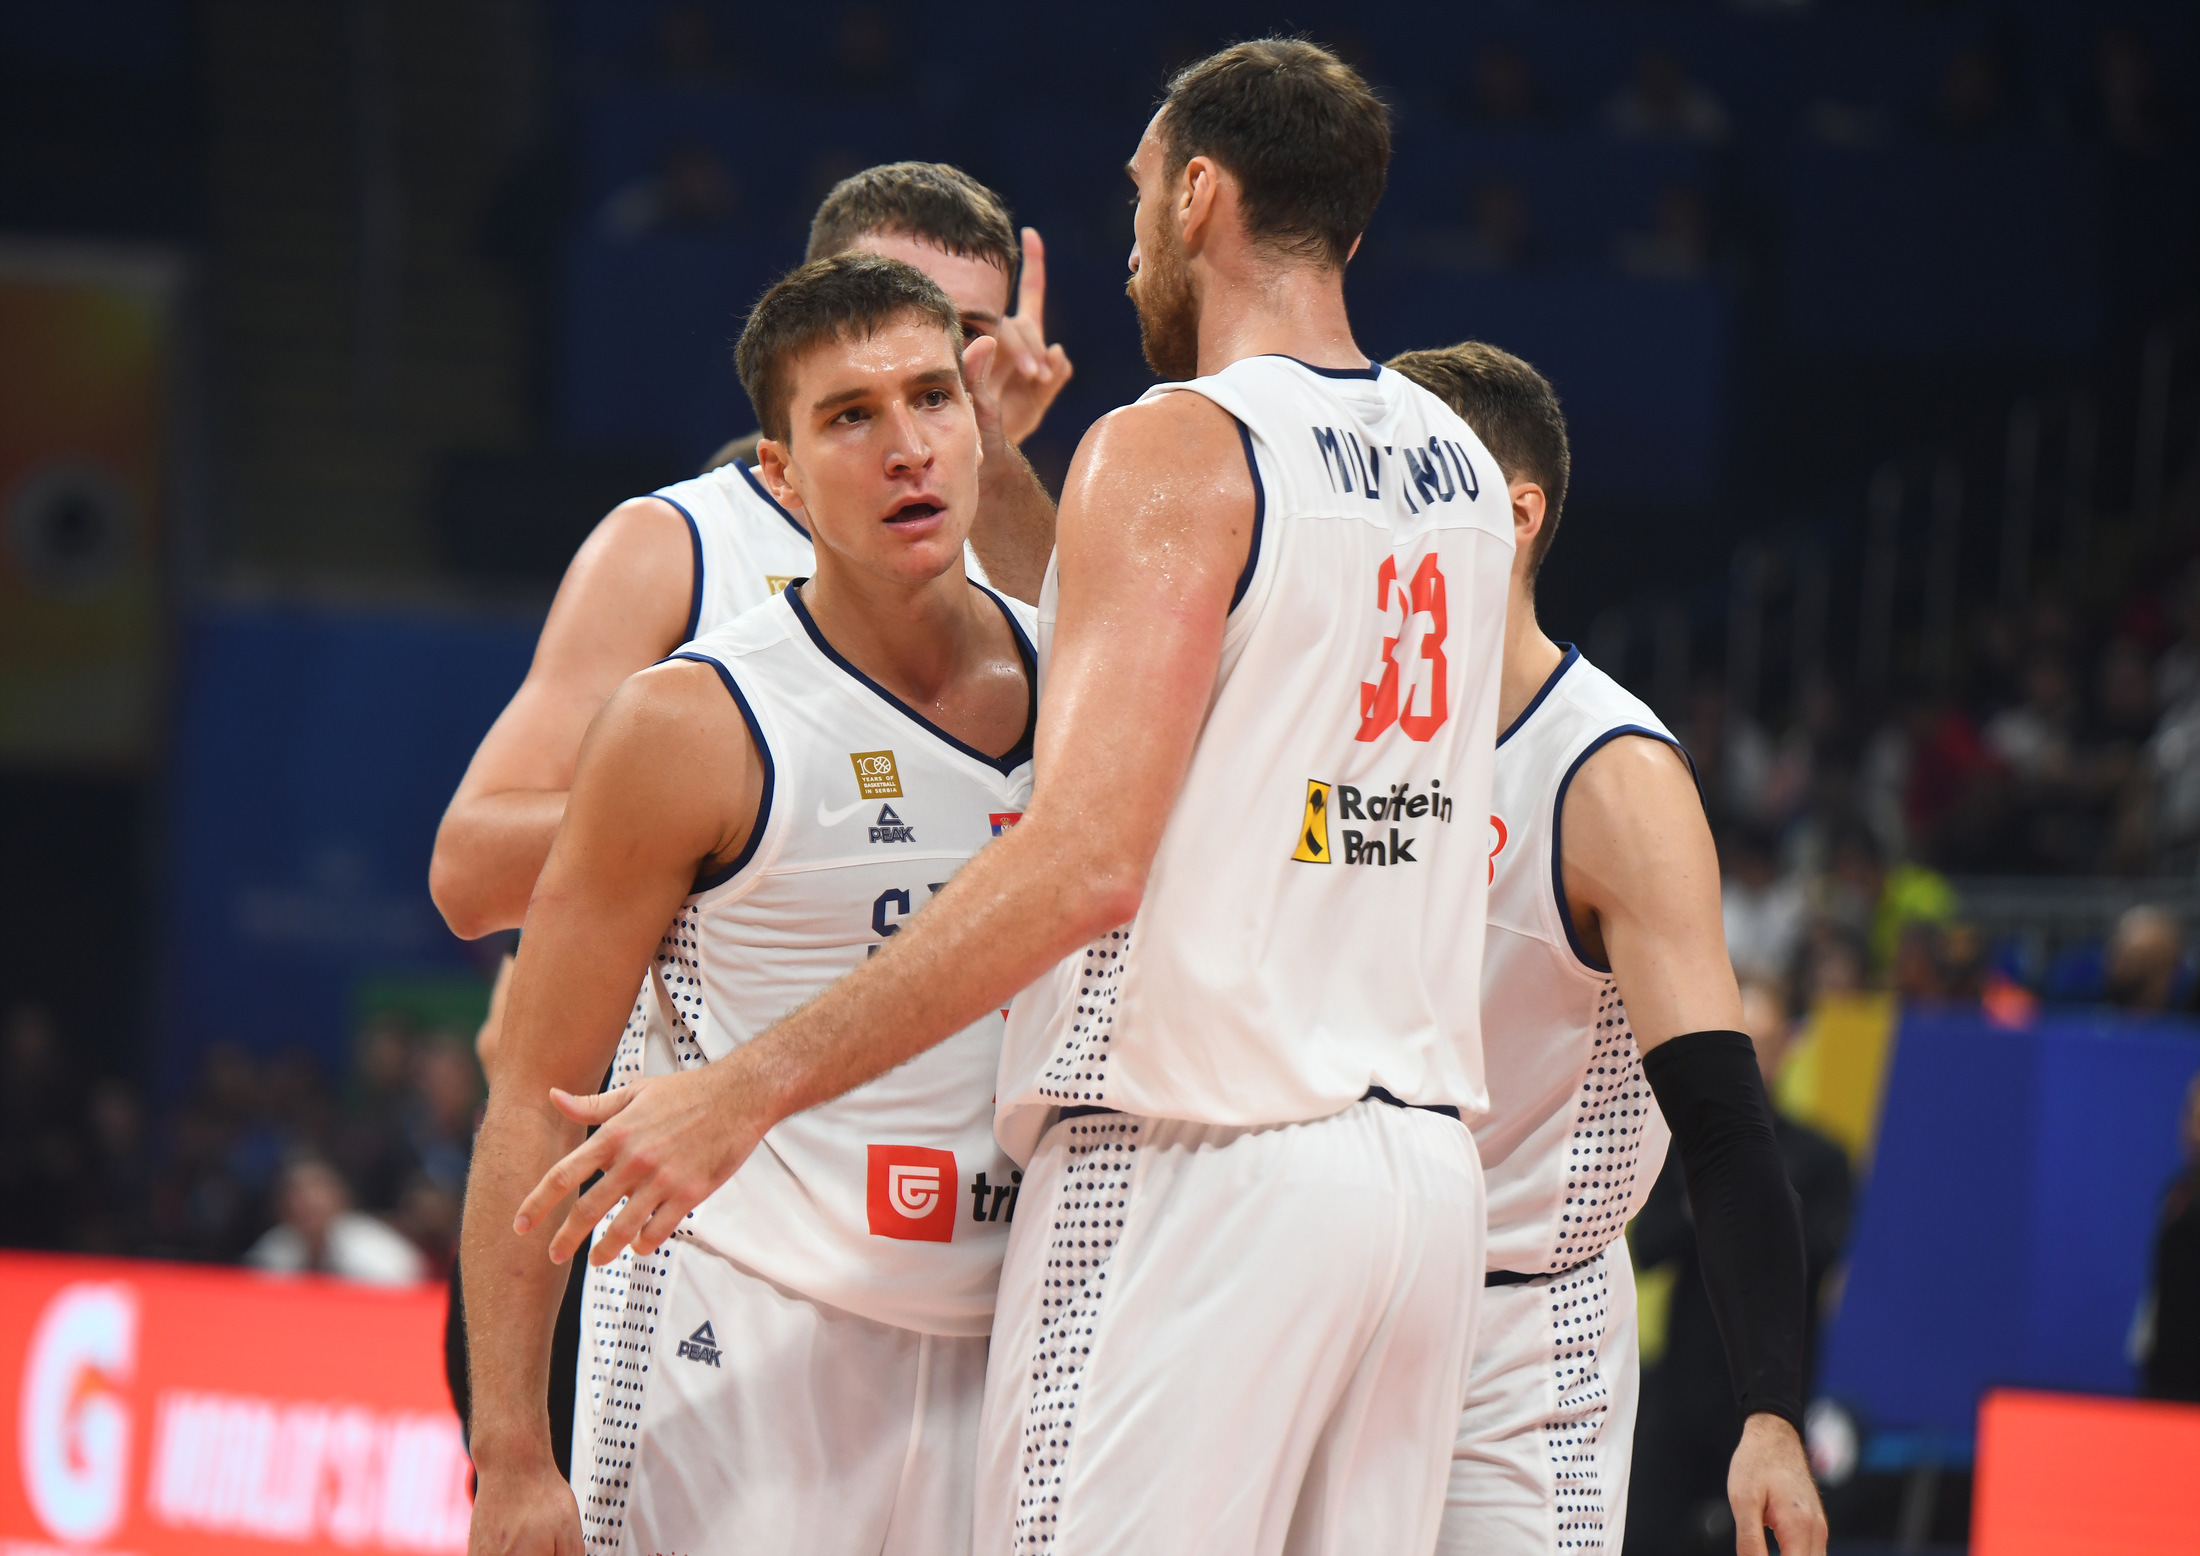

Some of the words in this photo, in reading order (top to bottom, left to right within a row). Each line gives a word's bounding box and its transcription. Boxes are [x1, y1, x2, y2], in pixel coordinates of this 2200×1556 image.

[1354, 553, 1447, 742] 33
[868, 827, 916, 843] PEAK
[676, 1340, 723, 1368] PEAK
